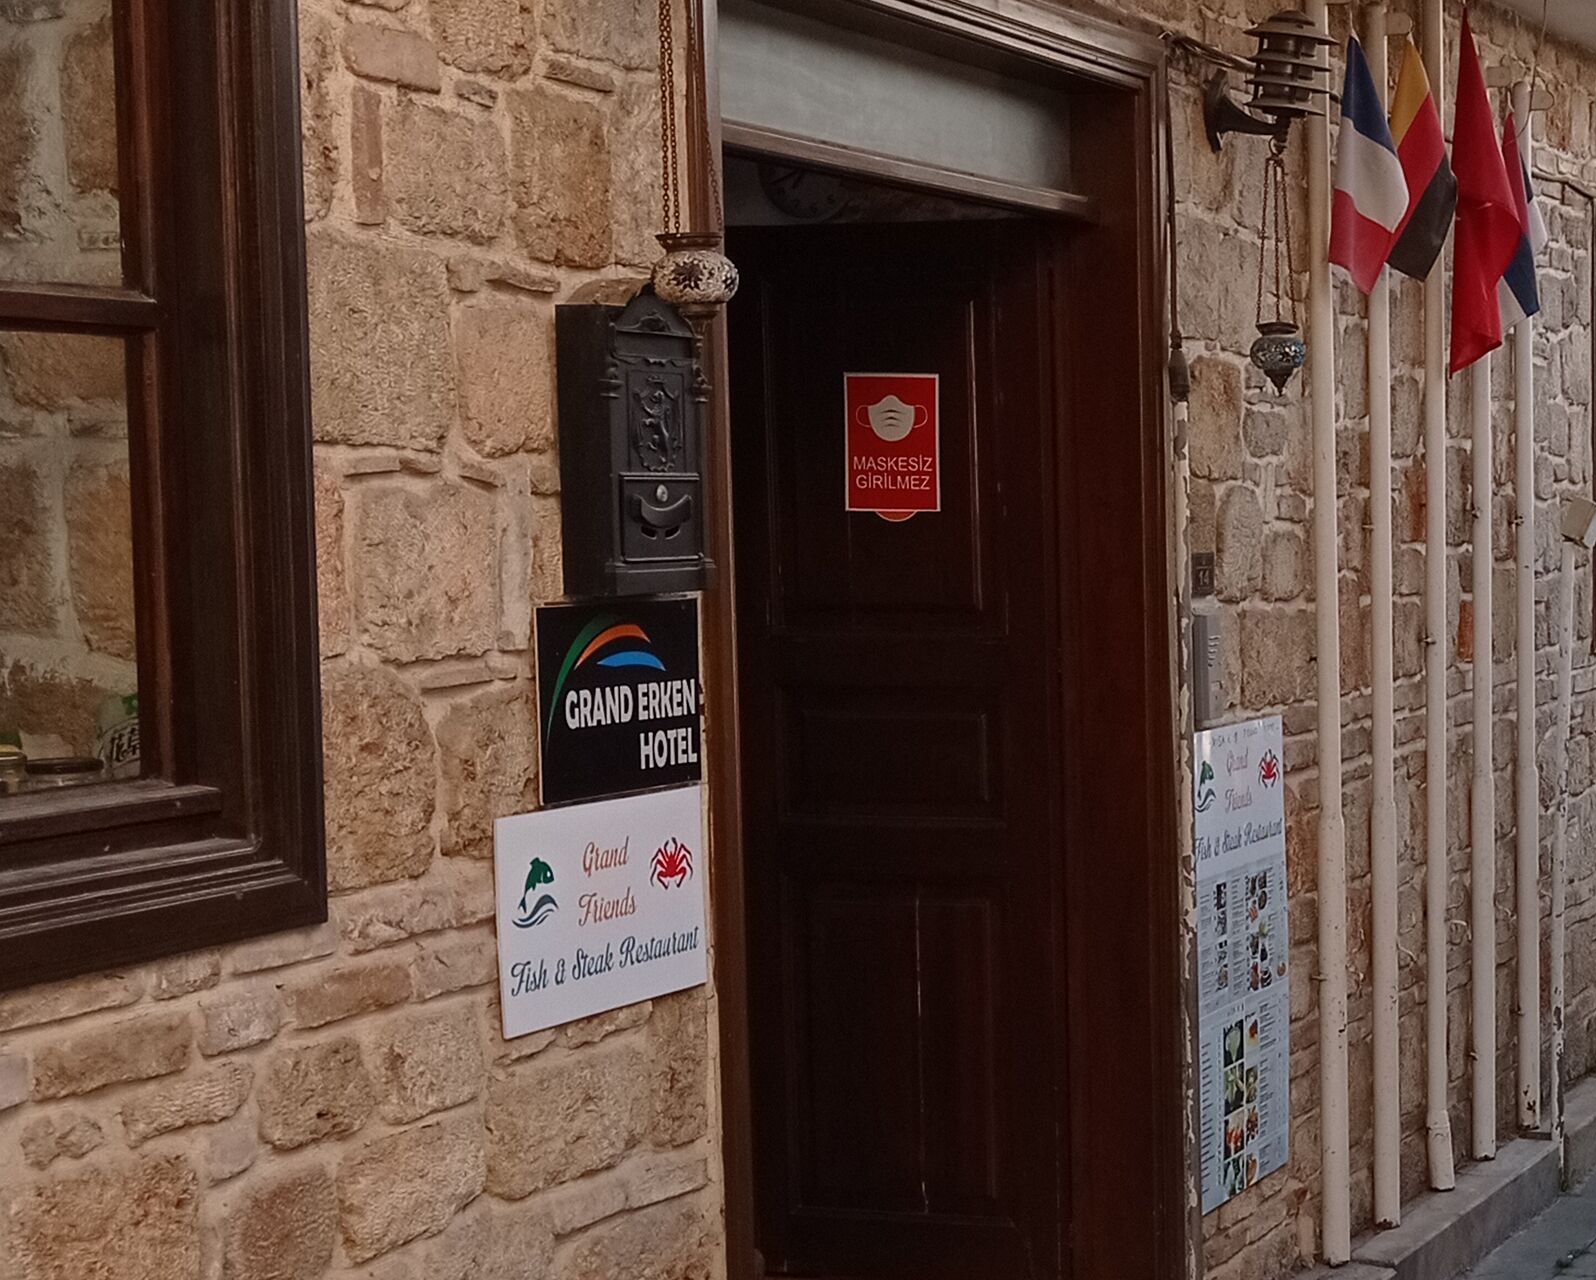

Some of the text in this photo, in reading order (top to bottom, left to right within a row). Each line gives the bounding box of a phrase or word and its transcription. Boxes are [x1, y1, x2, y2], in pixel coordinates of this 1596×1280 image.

[853, 455, 933, 472] MASKESİZ
[856, 473, 931, 490] GİRİLMEZ
[565, 678, 696, 730] GRAND ERKEN
[639, 727, 697, 770] HOTEL
[582, 835, 630, 877] Grand
[578, 886, 636, 927] Friends
[511, 926, 699, 997] Fish & Steak Restaurant
